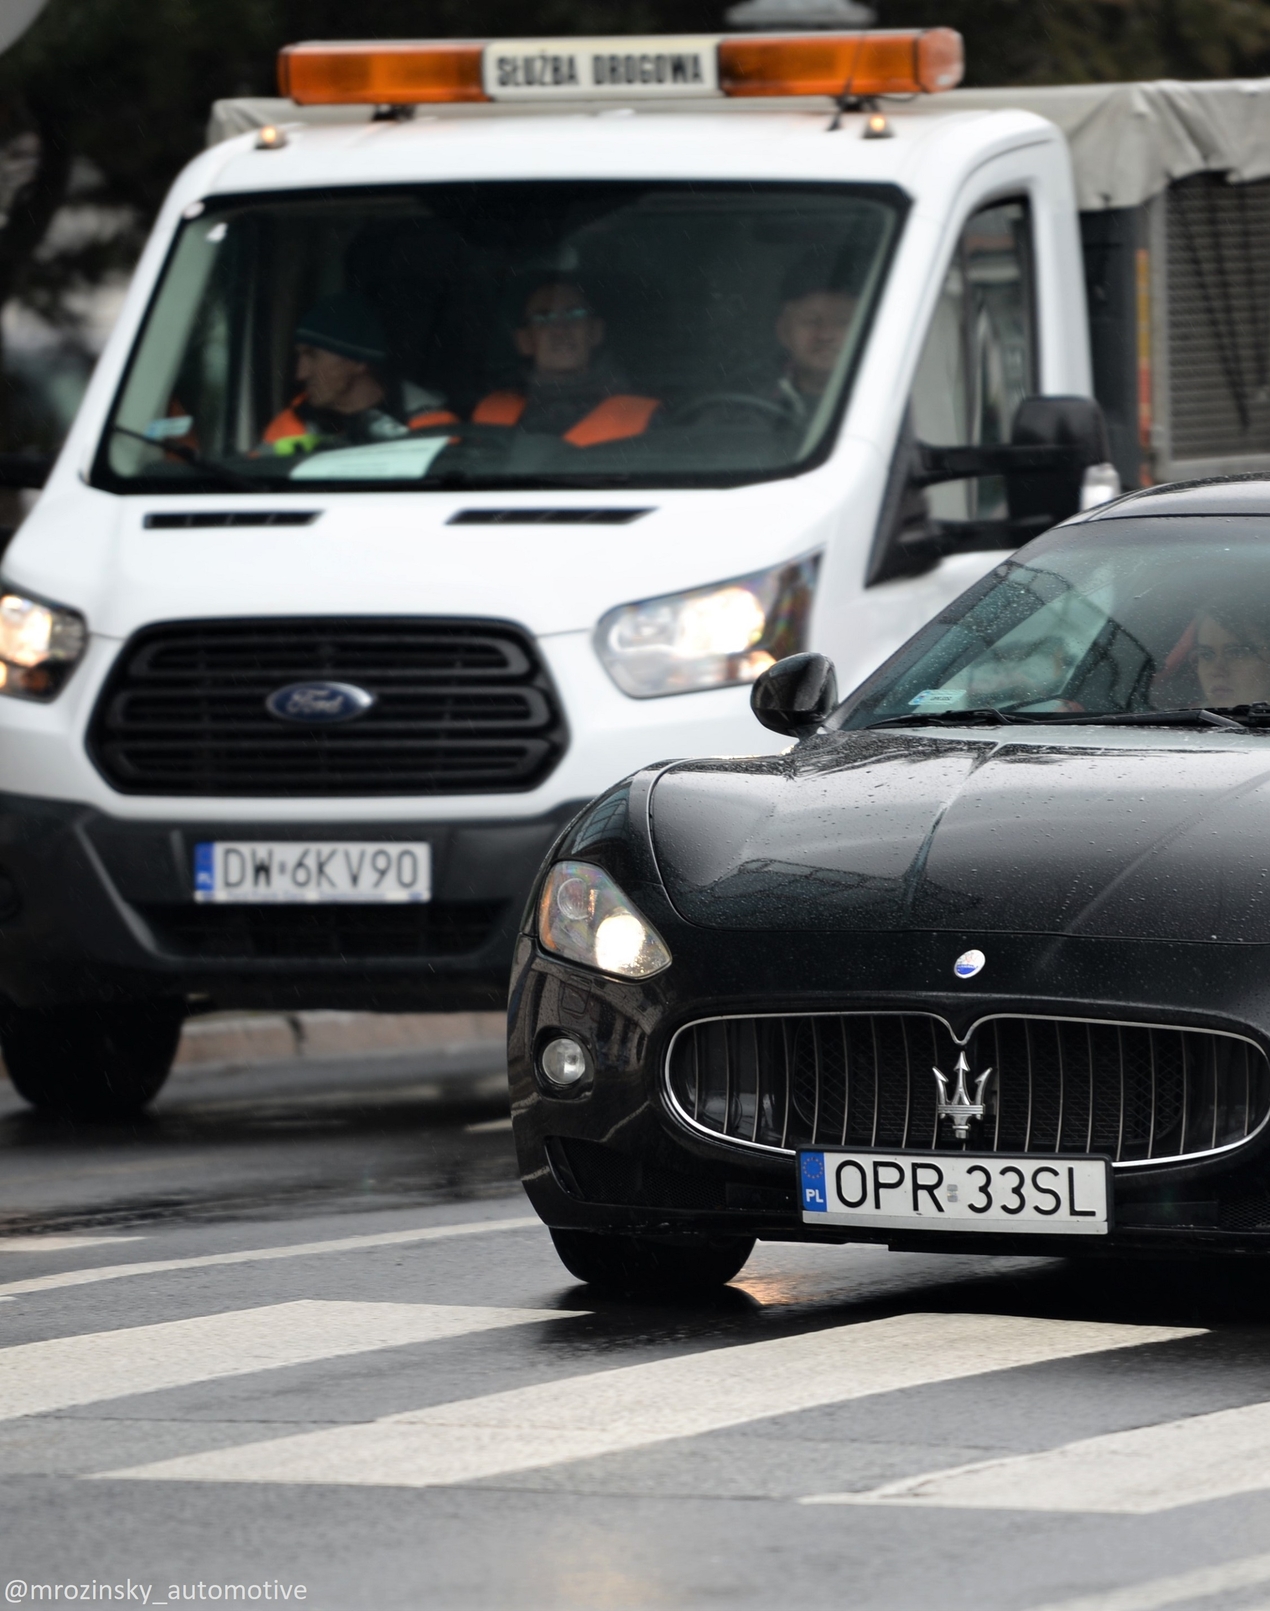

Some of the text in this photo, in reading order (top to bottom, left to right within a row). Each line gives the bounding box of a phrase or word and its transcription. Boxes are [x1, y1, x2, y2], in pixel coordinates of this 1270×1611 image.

[497, 50, 703, 86] SŁUŻBA DROGOWA
[223, 848, 418, 888] DW 6KV90
[805, 1188, 824, 1203] PL
[835, 1159, 1097, 1217] OPR 33SL
